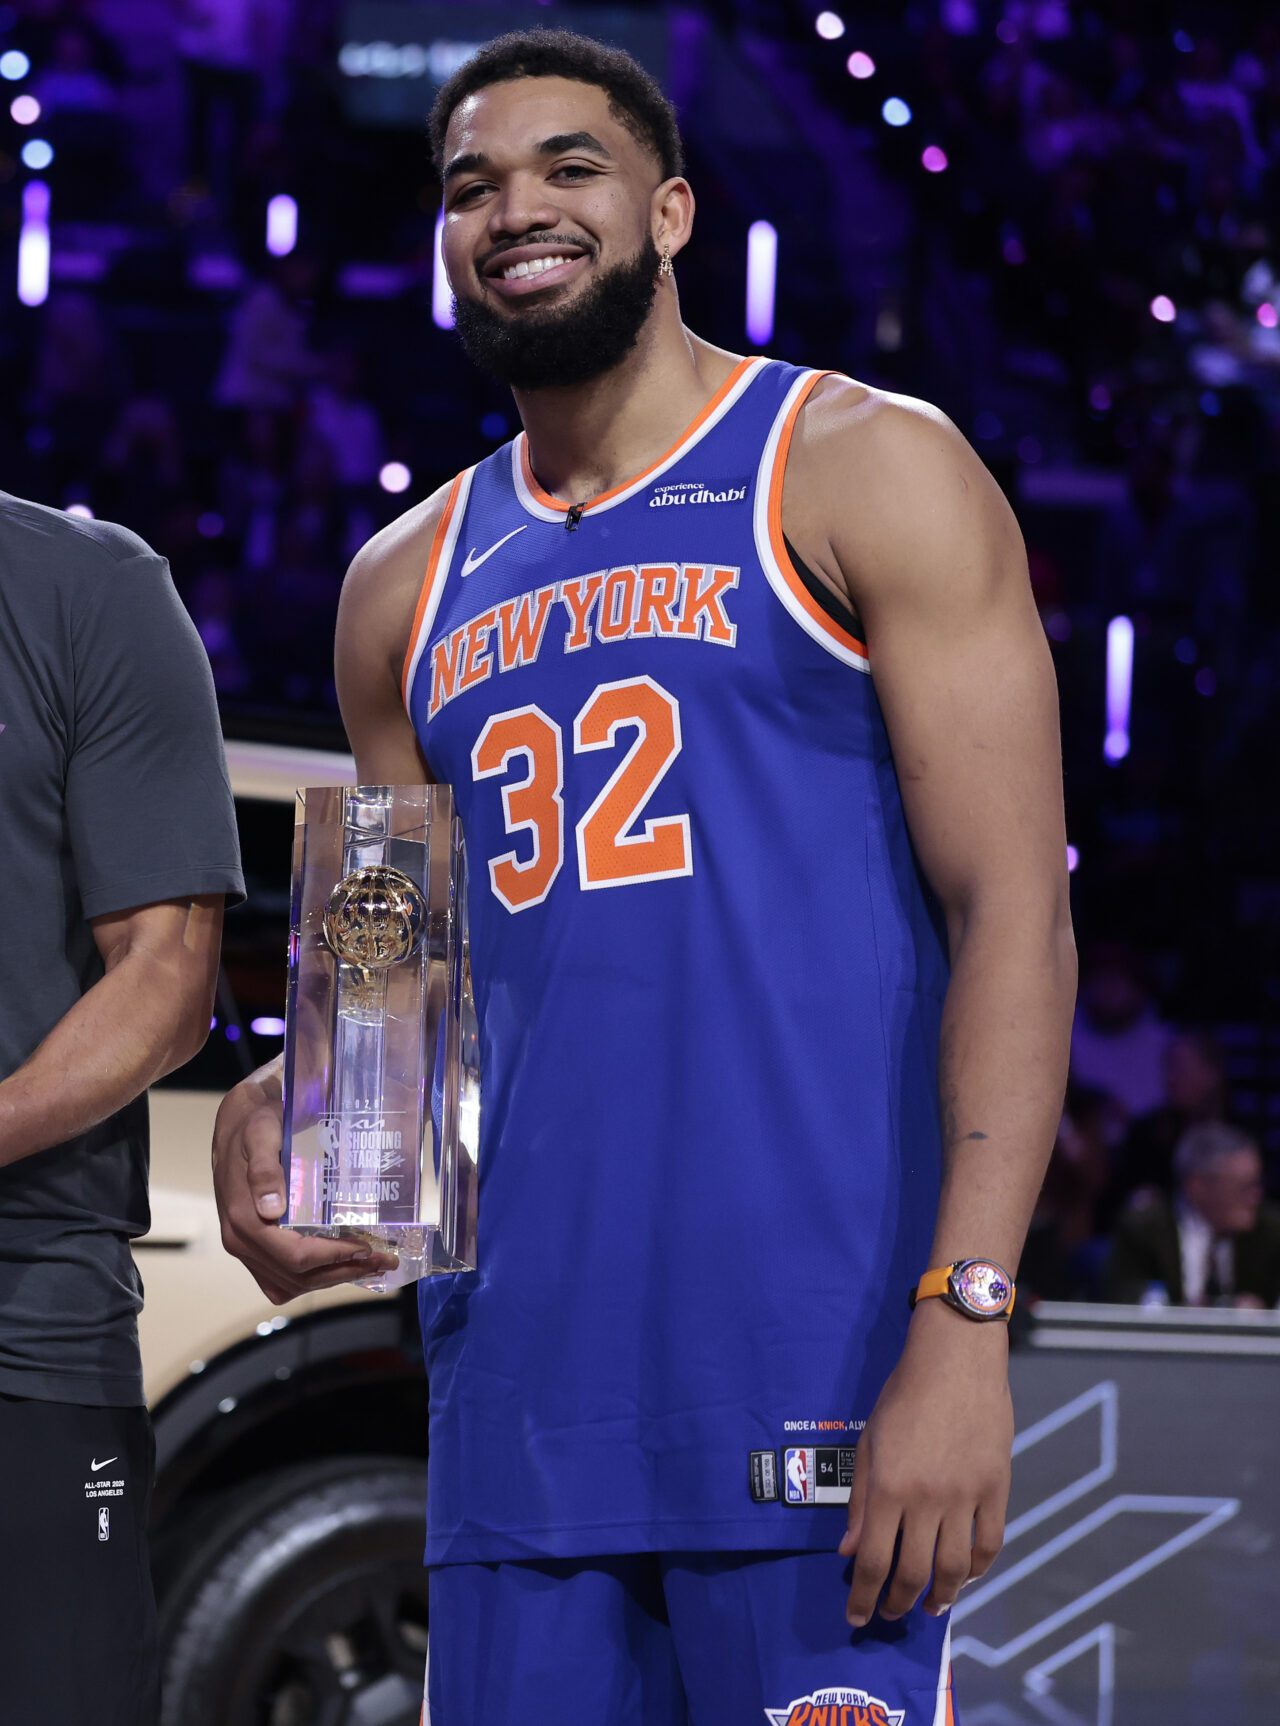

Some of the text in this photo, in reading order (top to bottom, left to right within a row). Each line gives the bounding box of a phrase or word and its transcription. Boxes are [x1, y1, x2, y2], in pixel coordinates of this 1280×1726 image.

[654, 482, 705, 493] experience
[649, 492, 686, 508] abu
[427, 562, 740, 724] NEW YORK
[470, 674, 694, 915] 32
[346, 1130, 402, 1150] SHOOTING
[346, 1150, 381, 1169] STARS
[320, 1181, 400, 1202] CHAMPIONS
[783, 1420, 810, 1431] ONCE
[810, 1420, 817, 1431] A
[848, 1420, 866, 1430] ALW
[820, 1462, 834, 1473] 54
[84, 1481, 111, 1489] ALL-STAR
[85, 1489, 124, 1498] LOS ANGELES
[789, 1489, 801, 1500] NBA
[814, 1692, 867, 1706] NEW YORK
